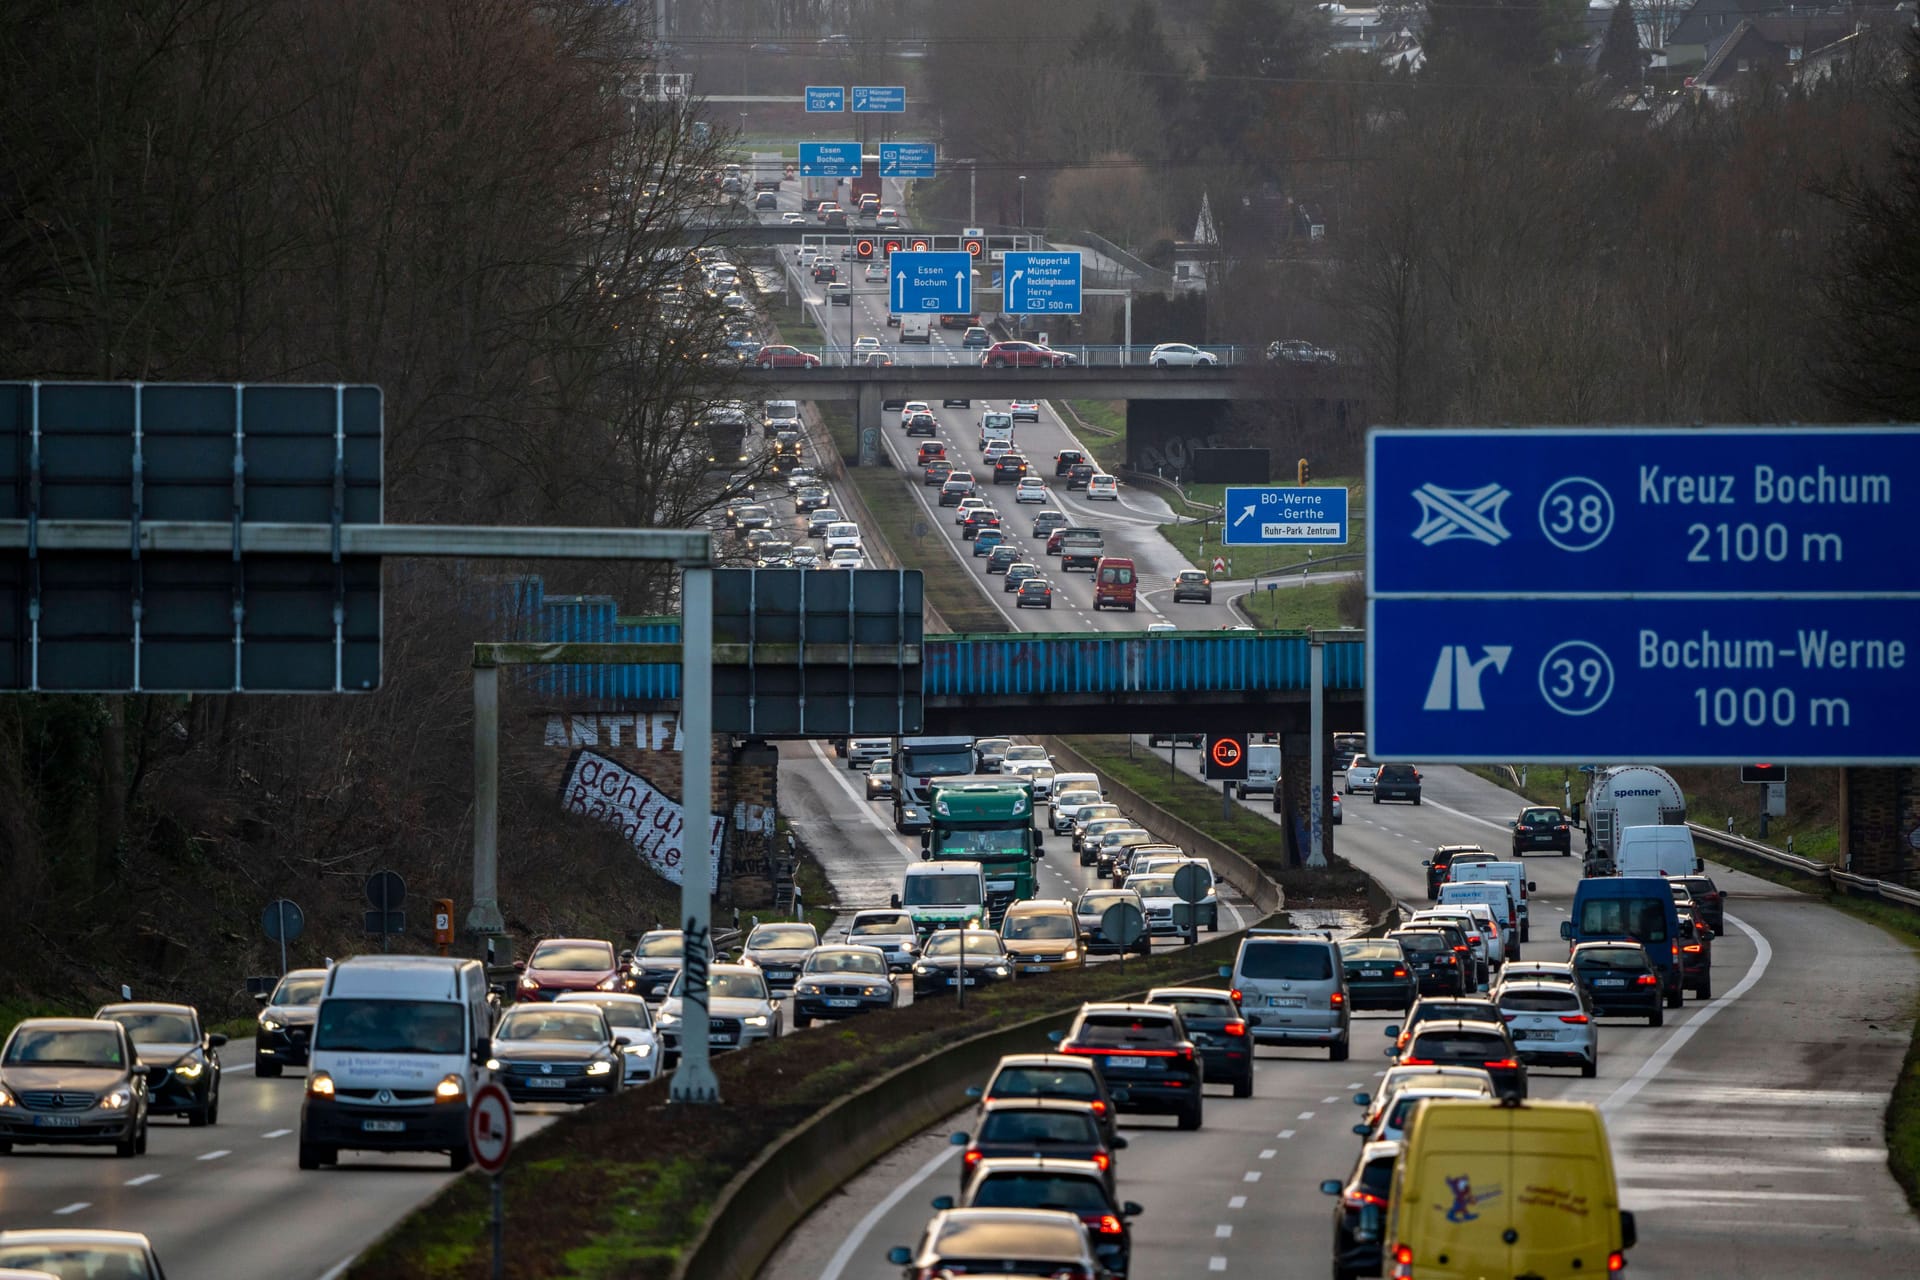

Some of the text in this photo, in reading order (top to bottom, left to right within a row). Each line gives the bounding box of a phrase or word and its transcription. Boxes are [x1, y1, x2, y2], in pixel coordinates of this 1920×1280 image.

[809, 91, 841, 99] Wuppertal
[820, 146, 841, 154] Essen
[1027, 257, 1071, 266] Wuppertal
[917, 266, 944, 275] Essen
[1027, 267, 1062, 276] Münster
[914, 279, 948, 287] Bochum
[1027, 278, 1076, 287] Recklinghausen
[1027, 288, 1053, 297] Herne
[1048, 301, 1063, 310] 500
[1639, 465, 1891, 504] Kreuz Bochum
[1261, 493, 1322, 504] BO-Werne
[1278, 508, 1325, 519] -Gerthe
[1551, 495, 1603, 533] 38
[1264, 526, 1337, 535] Ruhr-Park Zentrum
[1687, 523, 1843, 562] 2100 m
[1639, 630, 1905, 669] Bochum-Werne
[1551, 659, 1602, 697] 39
[1693, 688, 1850, 726] 1000 m
[1614, 789, 1662, 798] spenner
[569, 784, 683, 868] Bandite
